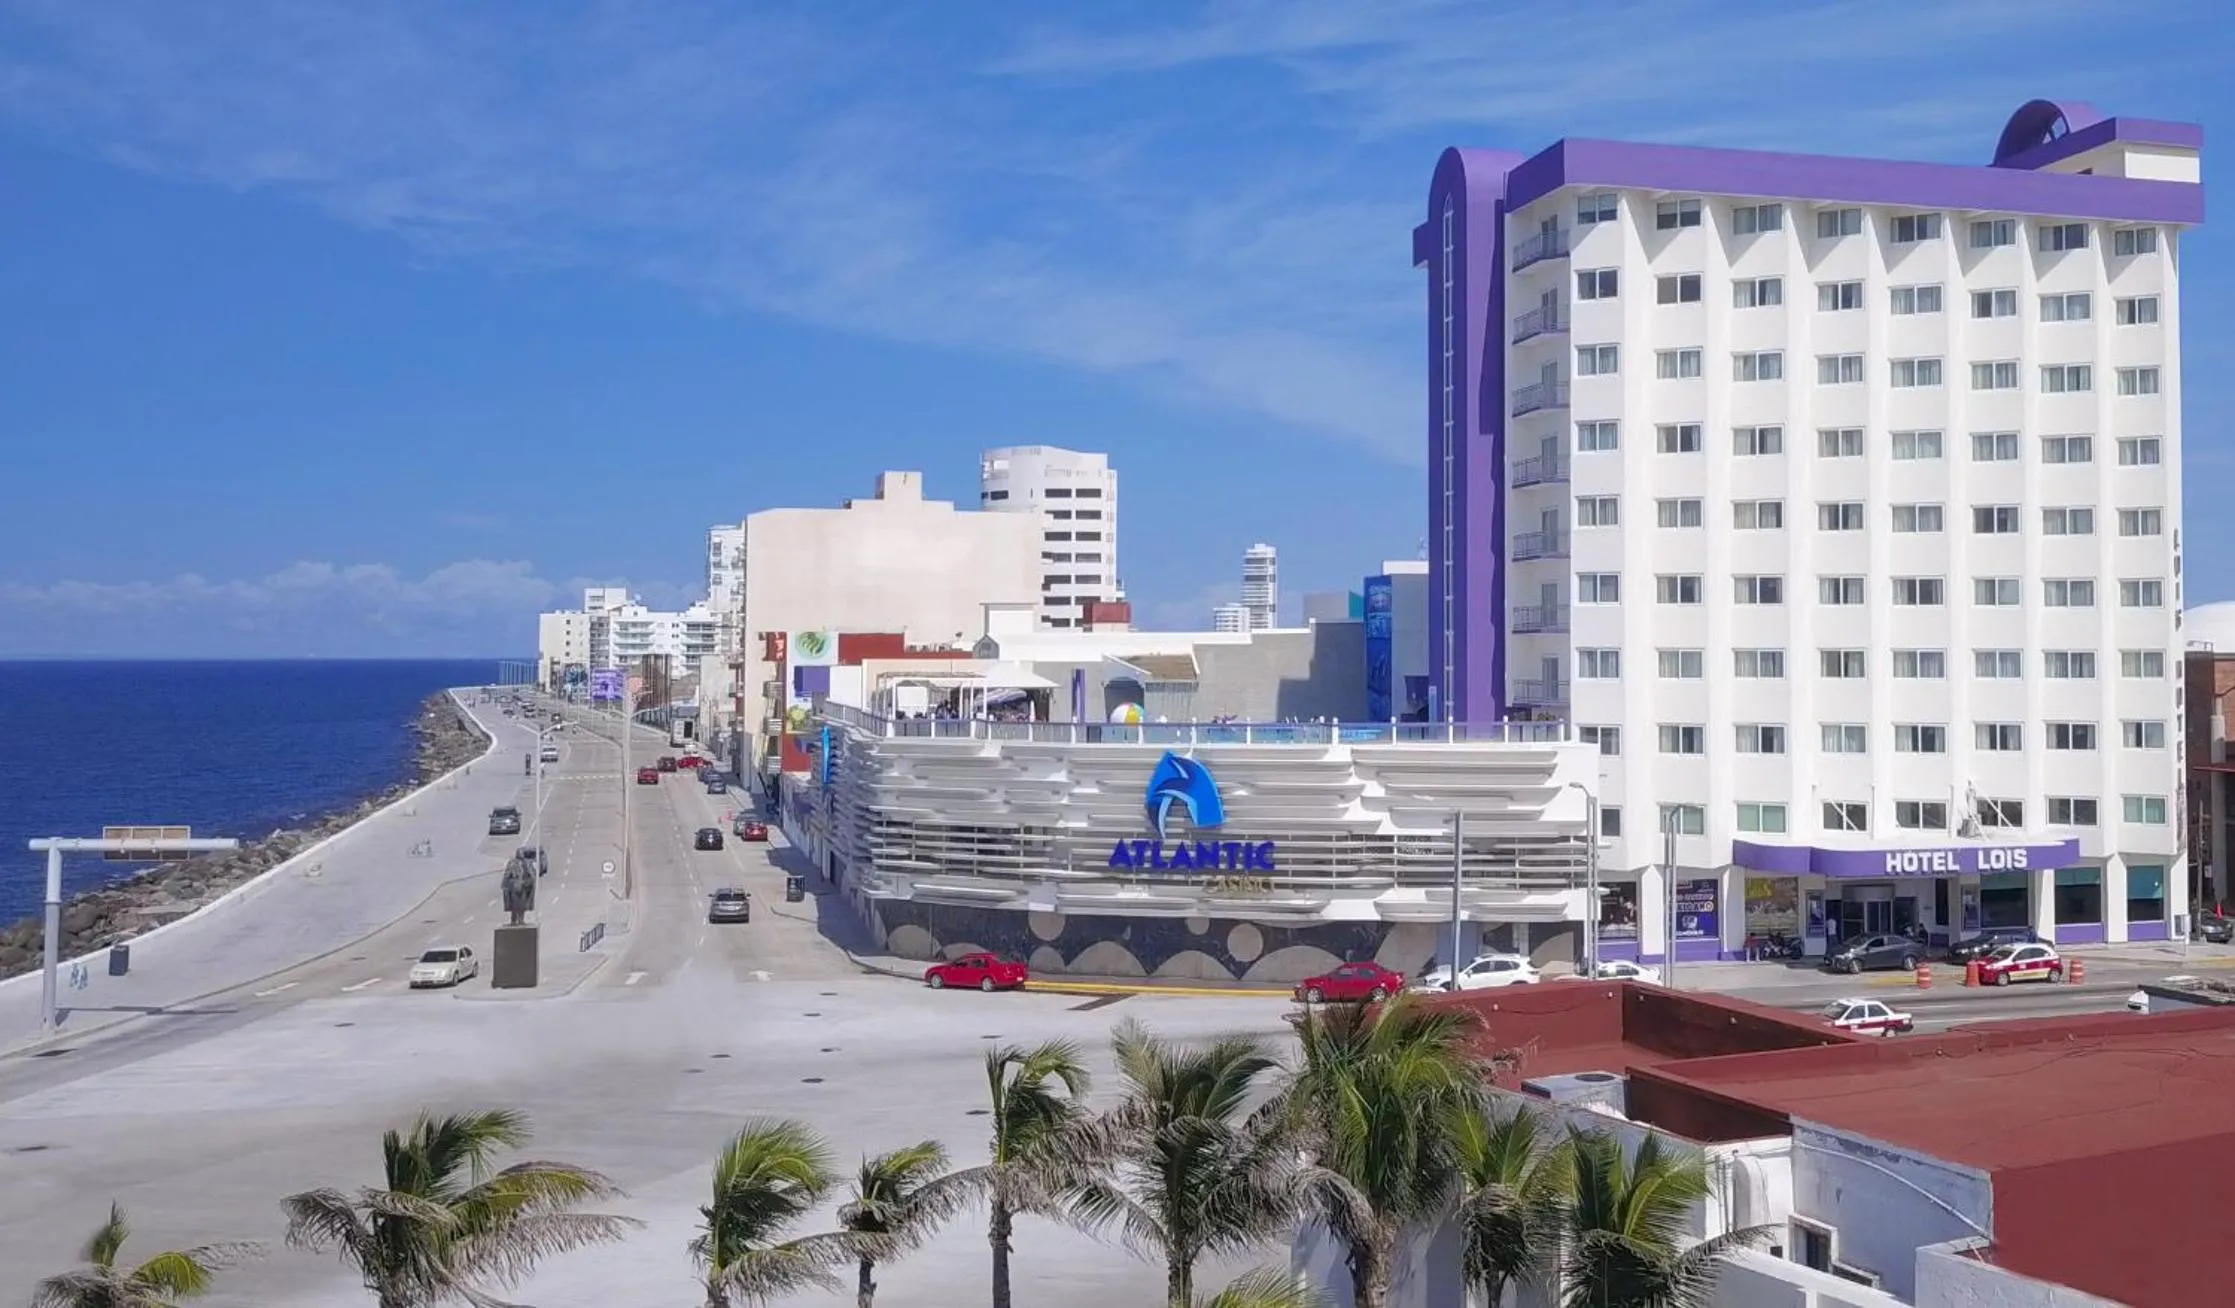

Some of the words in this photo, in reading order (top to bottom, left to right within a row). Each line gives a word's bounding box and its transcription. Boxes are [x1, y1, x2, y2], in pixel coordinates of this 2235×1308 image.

[1108, 838, 1275, 870] ATLANTIC
[1886, 851, 1960, 873] HOTEL
[1978, 848, 2027, 870] LOIS
